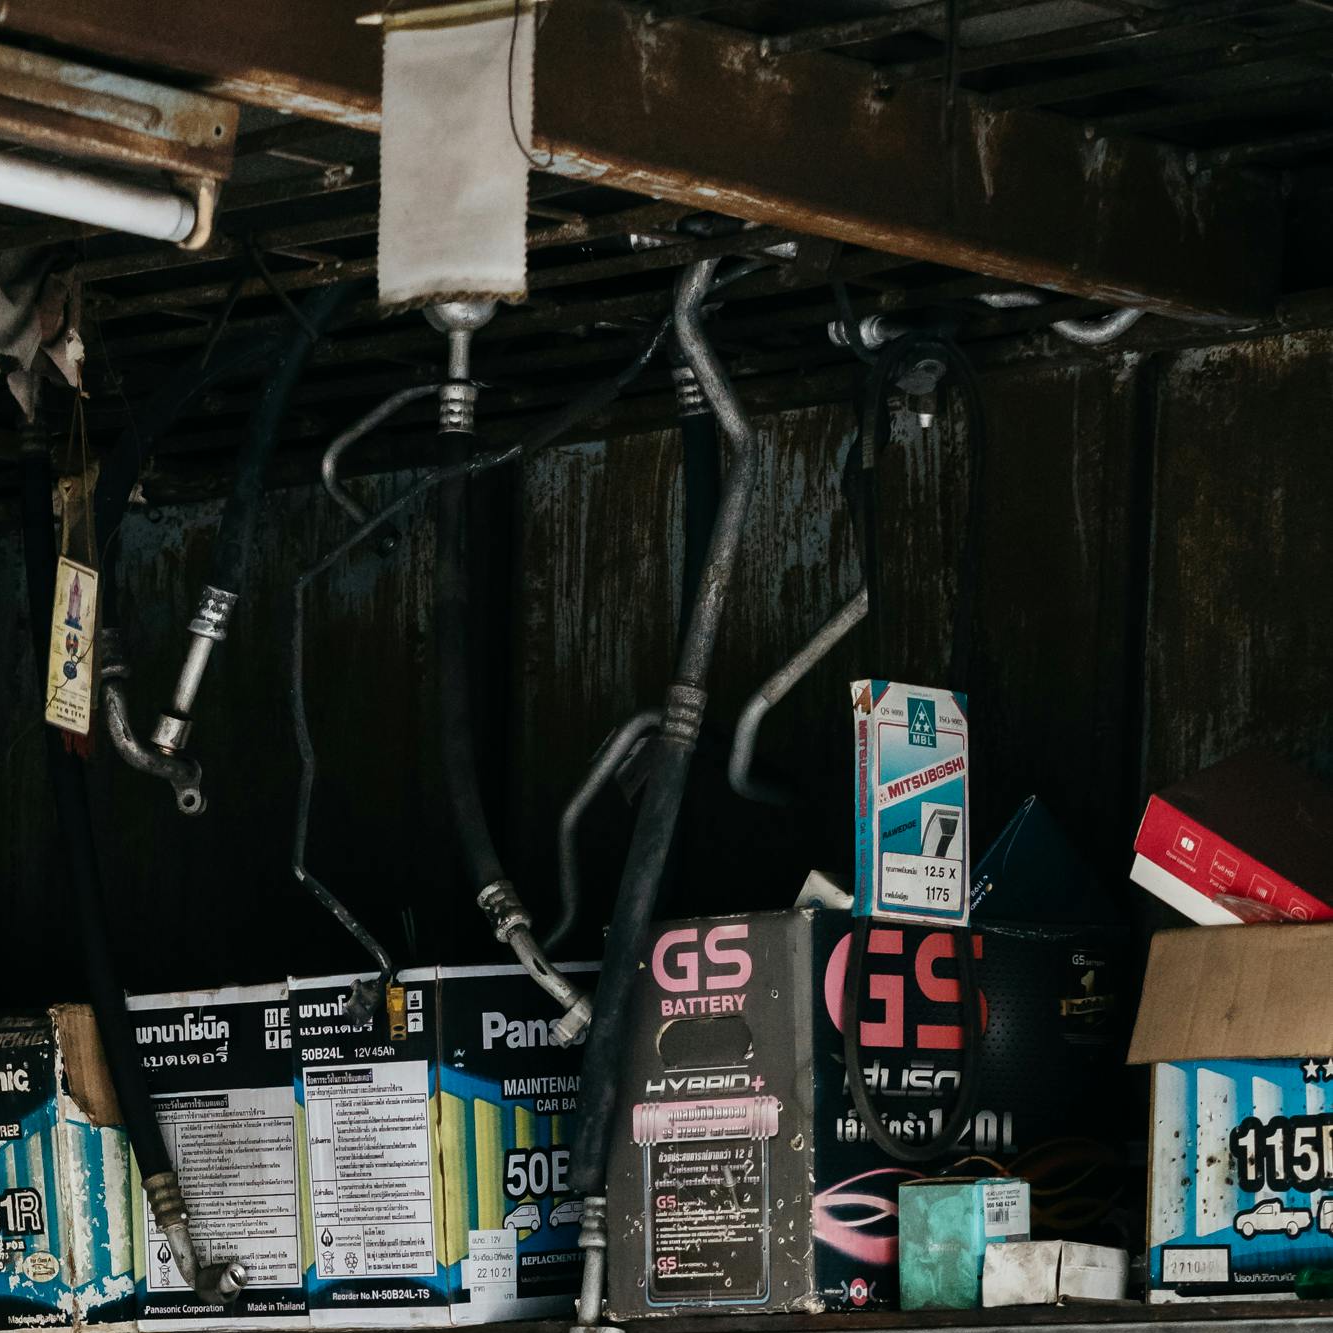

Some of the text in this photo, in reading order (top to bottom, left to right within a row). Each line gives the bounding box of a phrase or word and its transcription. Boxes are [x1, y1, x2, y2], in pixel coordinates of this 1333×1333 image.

[912, 734, 933, 747] MBL
[887, 756, 966, 800] MITSUBOSHI
[881, 819, 917, 841] RAWEDGE
[924, 864, 956, 880] 12.5 X
[925, 886, 950, 903] 1175
[651, 924, 753, 993] GS
[824, 928, 989, 1050] GS
[660, 993, 747, 1017] BATTERY
[301, 1046, 395, 1062] 50B24L 12V 45Ah
[536, 1098, 557, 1111] CAR
[656, 1195, 677, 1210] GS
[657, 1256, 677, 1271] GS
[477, 1267, 512, 1279] 22 10 21
[332, 1290, 360, 1300] Reorder
[182, 1302, 224, 1315] Corporation
[247, 1299, 306, 1312] Made Thailand
